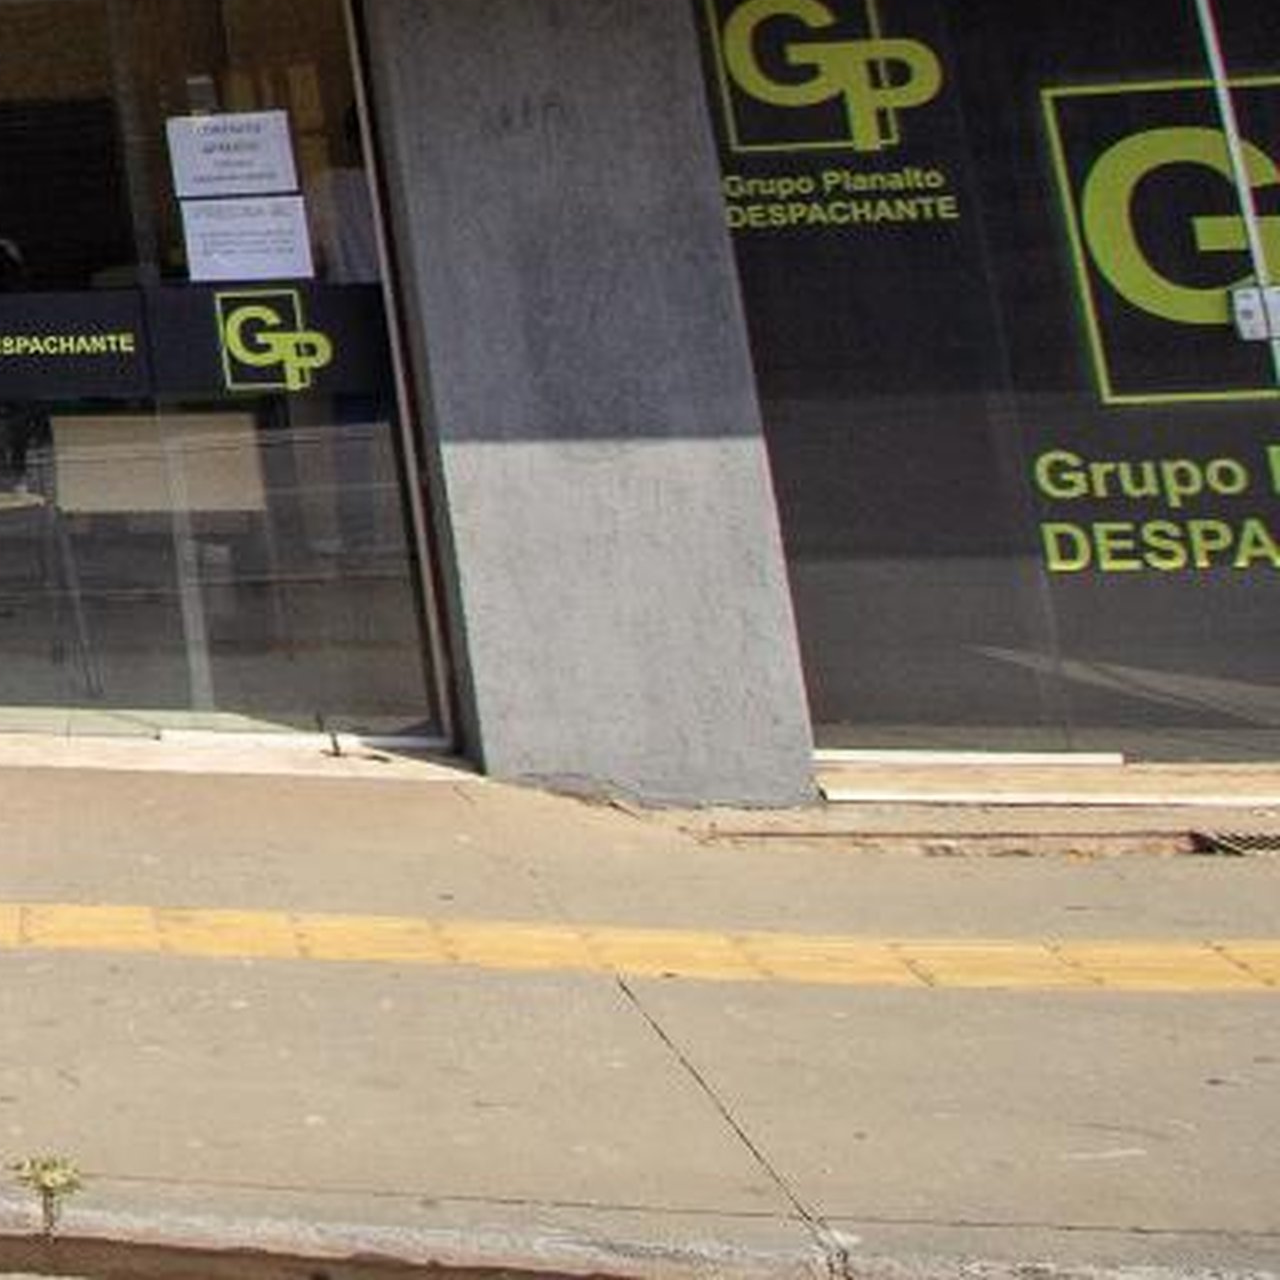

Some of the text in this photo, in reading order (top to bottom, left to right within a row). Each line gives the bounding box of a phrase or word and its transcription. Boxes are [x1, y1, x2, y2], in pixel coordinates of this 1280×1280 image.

[725, 168, 945, 200] Grupo Planalto
[726, 195, 960, 228] DESPACHANTE
[1036, 451, 1248, 507] Grupo
